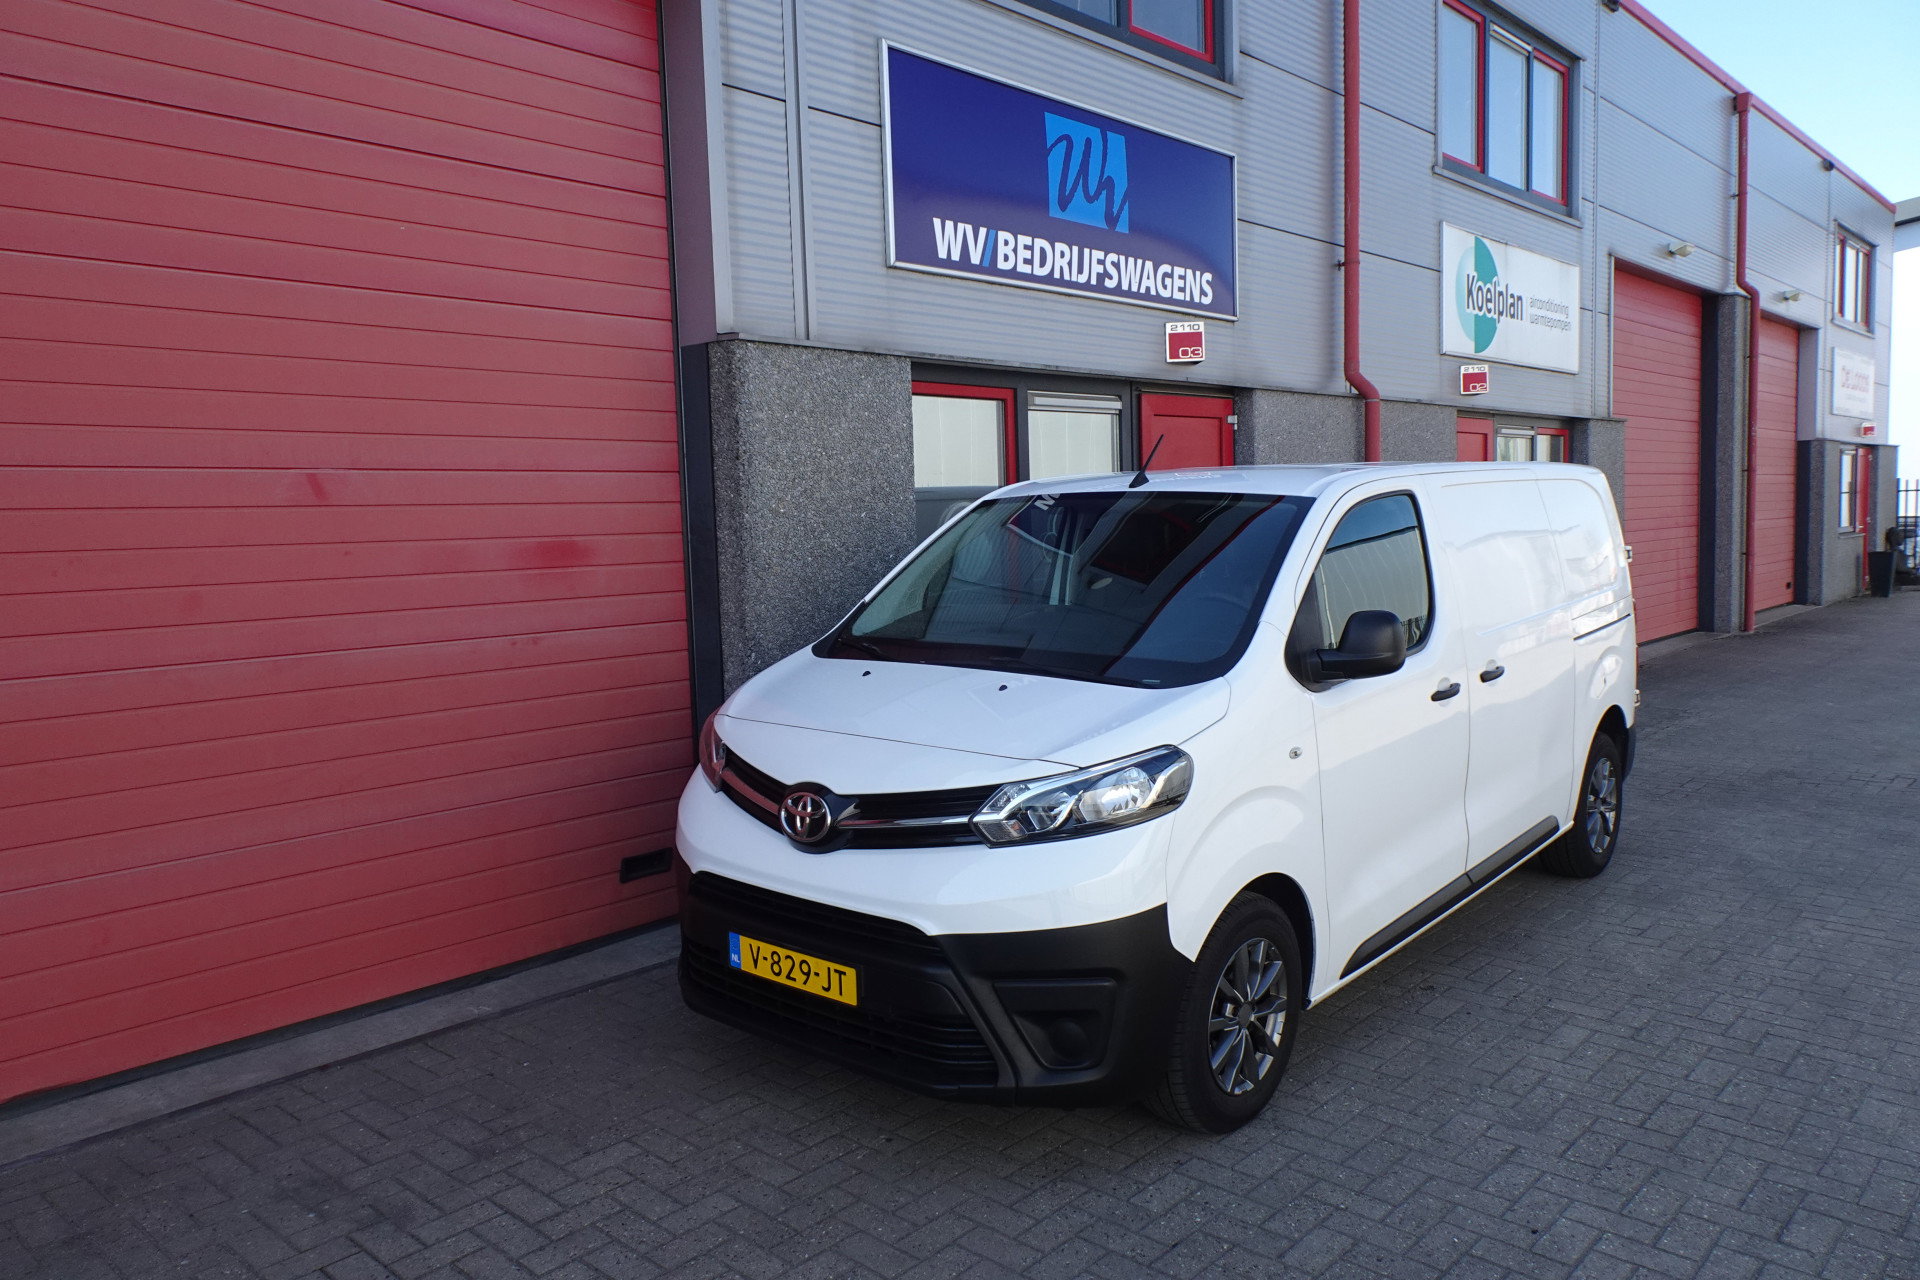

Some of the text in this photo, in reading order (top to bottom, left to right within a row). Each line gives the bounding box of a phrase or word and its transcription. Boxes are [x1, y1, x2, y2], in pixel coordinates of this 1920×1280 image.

[1466, 273, 1523, 324] Koelplan
[1170, 323, 1201, 332] 2110
[1179, 346, 1203, 359] 03
[1470, 382, 1488, 392] 02
[731, 952, 741, 963] NL
[749, 943, 847, 996] V-829-JT
